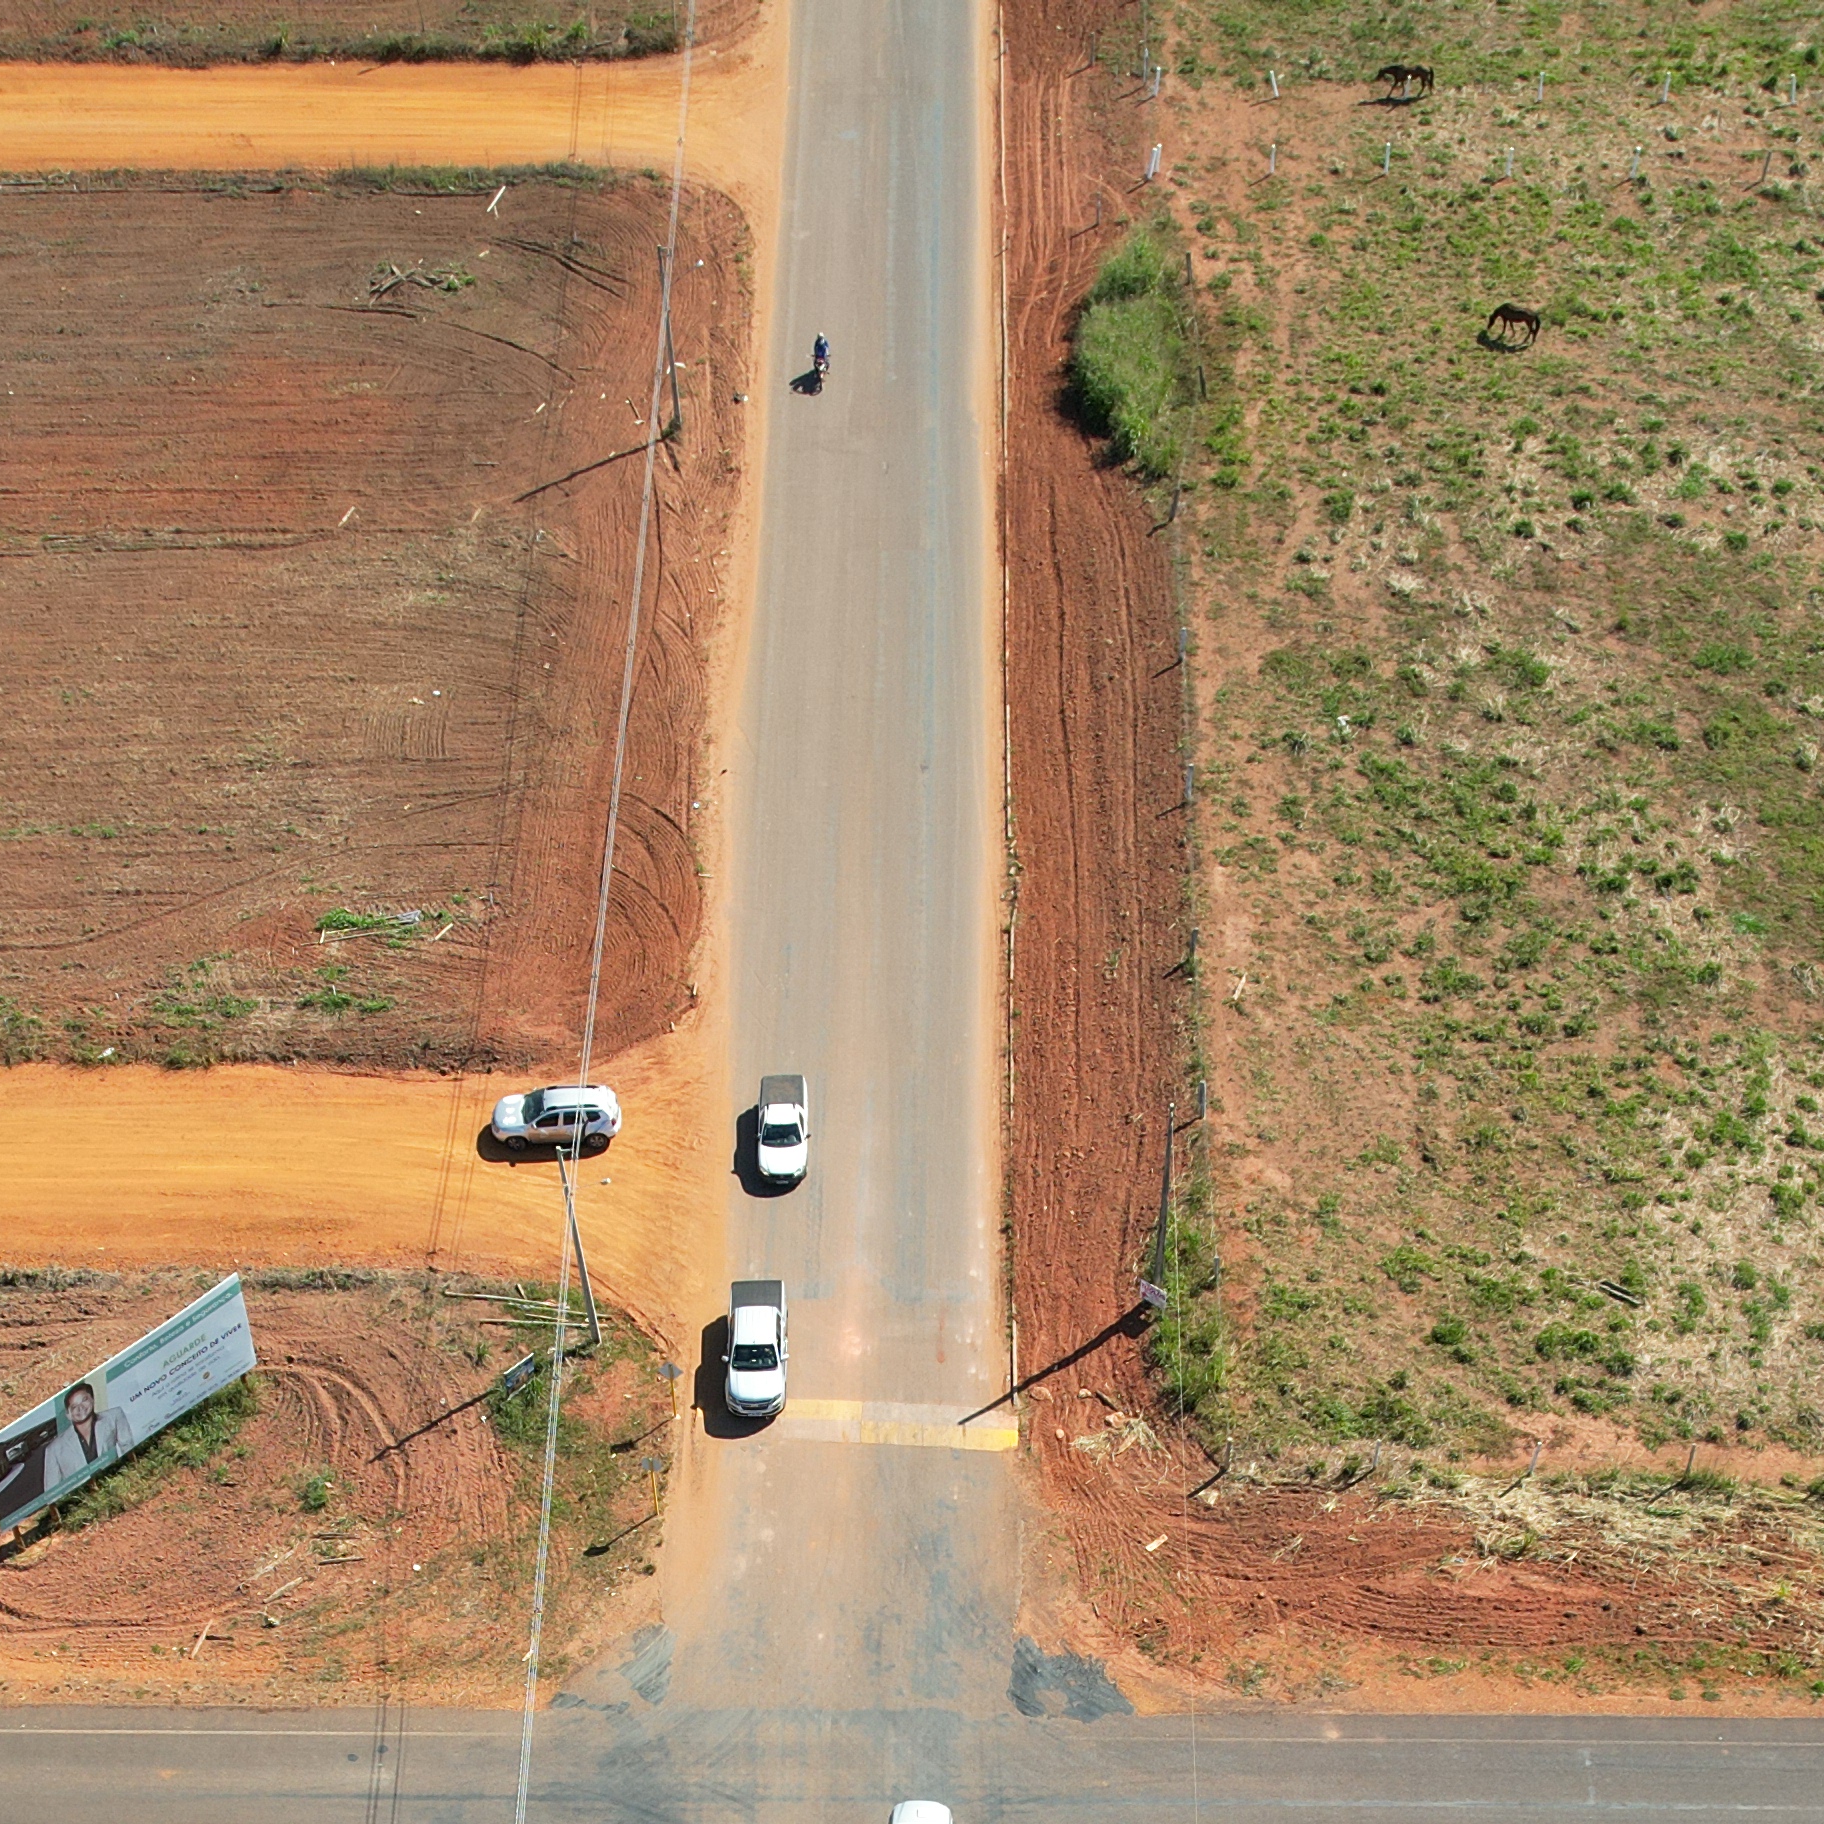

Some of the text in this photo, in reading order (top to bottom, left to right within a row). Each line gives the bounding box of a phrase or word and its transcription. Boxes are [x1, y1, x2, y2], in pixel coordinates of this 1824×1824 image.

[128, 1389, 142, 1403] UM
[143, 1372, 167, 1393] NOVO
[168, 1344, 208, 1376] CONCEITO
[209, 1337, 219, 1348] DE
[220, 1321, 242, 1340] VIVER
[161, 1332, 206, 1368] AGUARDE
